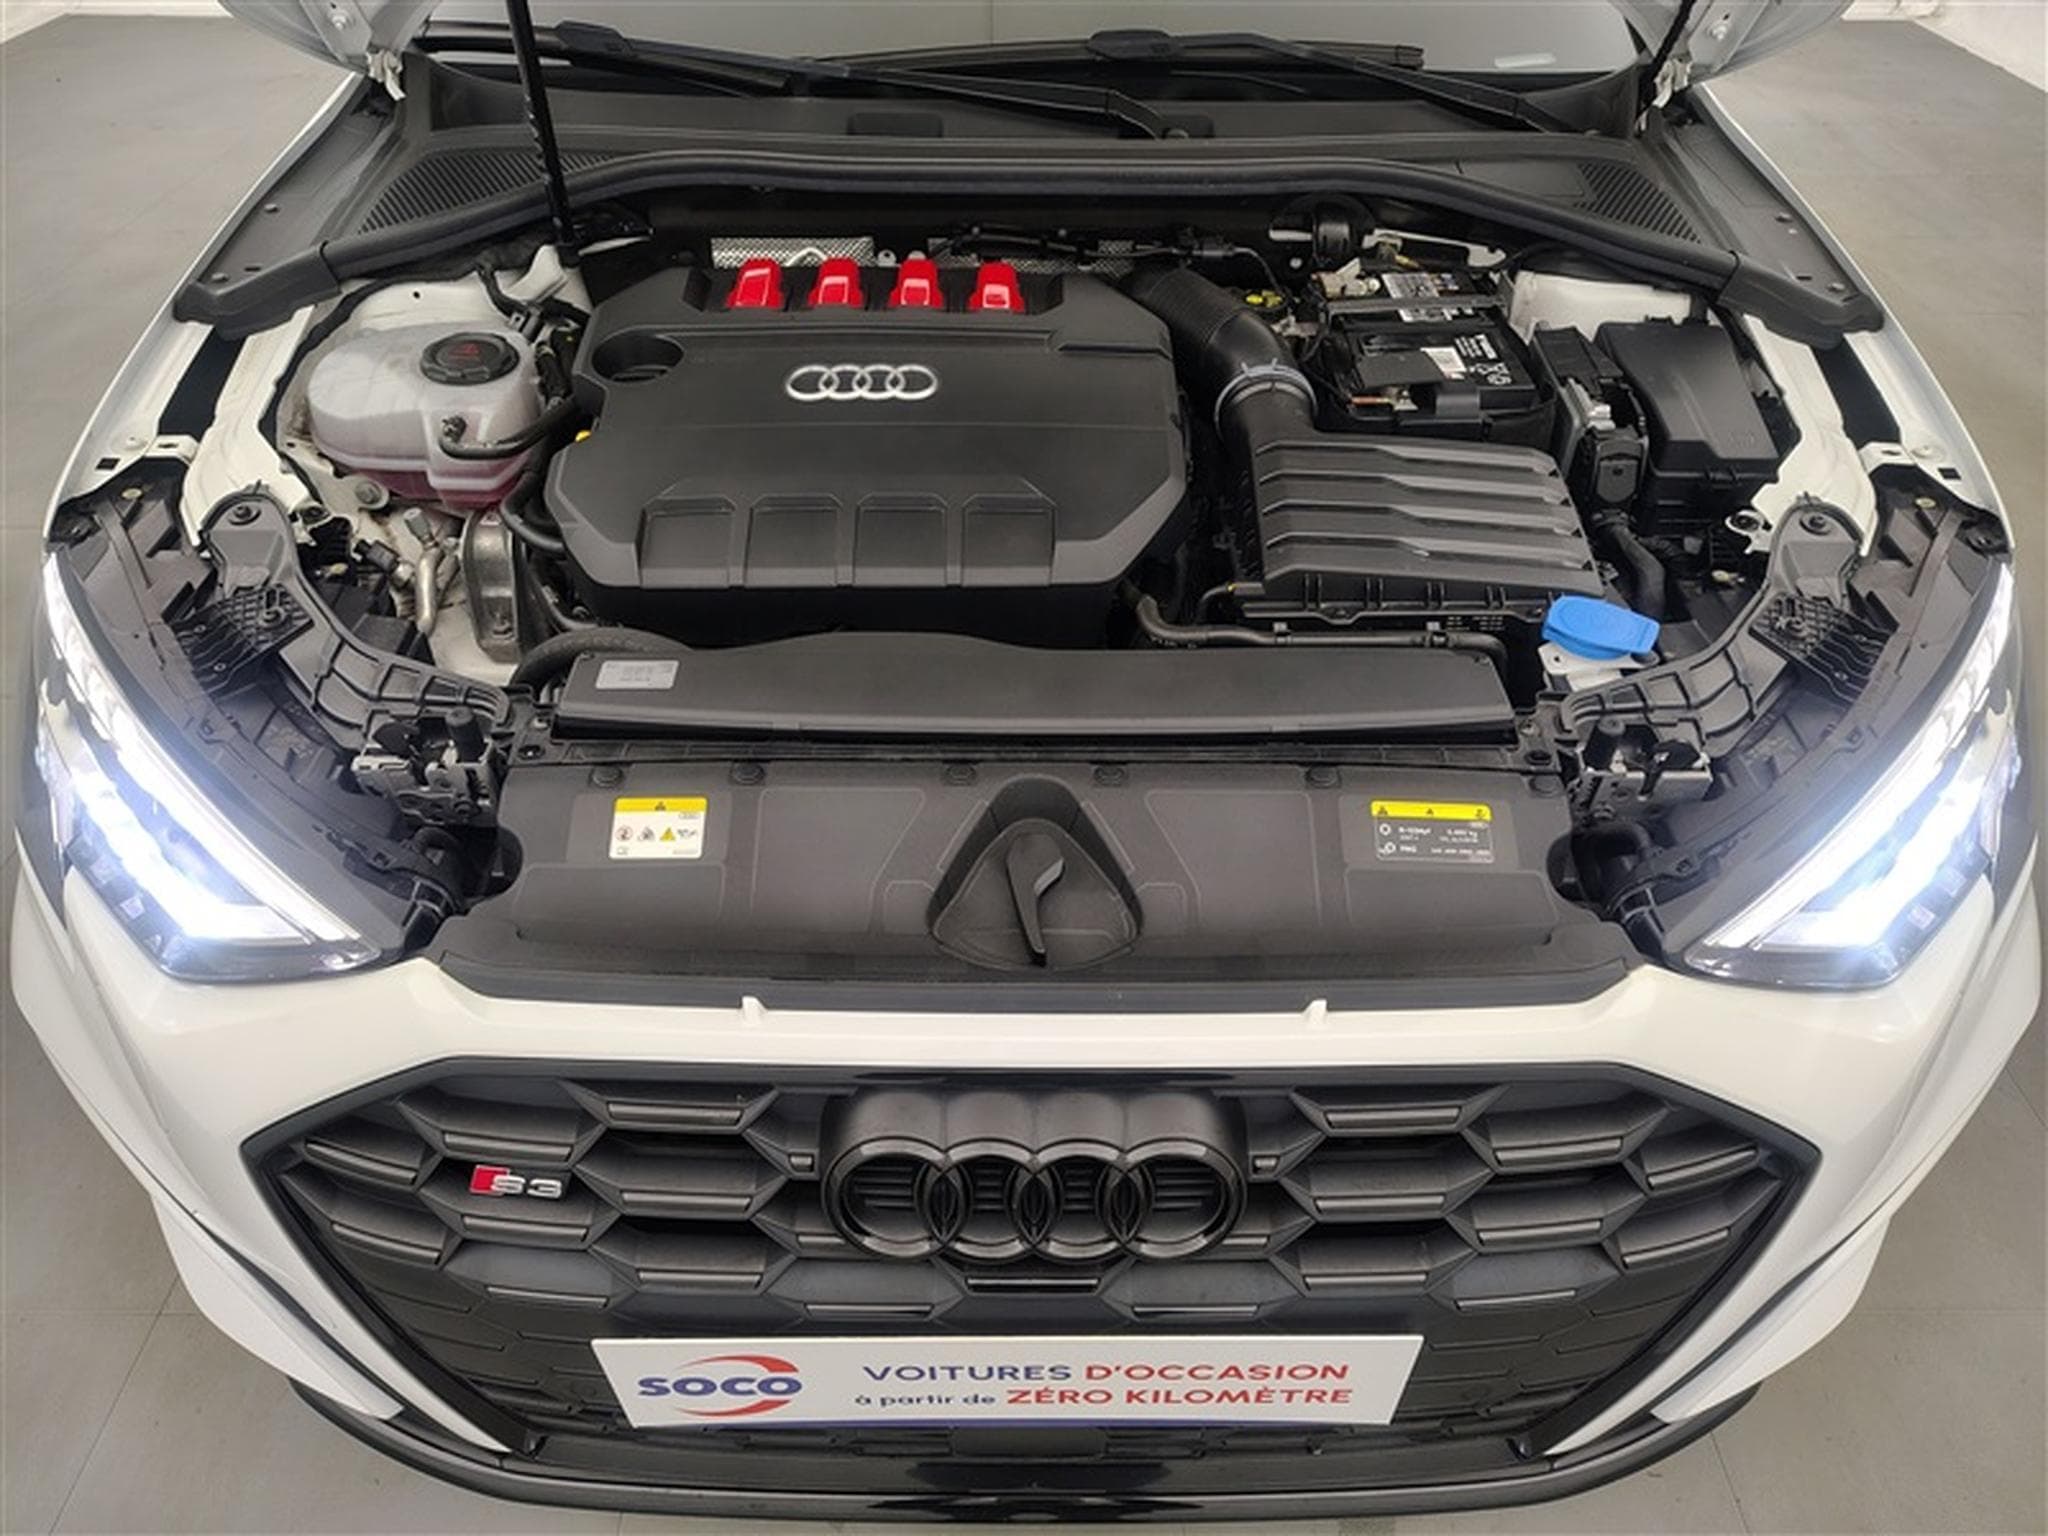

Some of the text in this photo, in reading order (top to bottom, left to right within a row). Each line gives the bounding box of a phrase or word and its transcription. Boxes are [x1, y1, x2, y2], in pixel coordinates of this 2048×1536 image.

[490, 1174, 562, 1198] S3
[862, 1364, 1349, 1381] VOITURES D'OCCASION
[637, 1377, 803, 1397] SOCO
[880, 1394, 953, 1408] partir
[962, 1394, 996, 1405] de
[1006, 1387, 1113, 1405] ZÉRO
[1125, 1387, 1353, 1404] KILOMÈTRE
